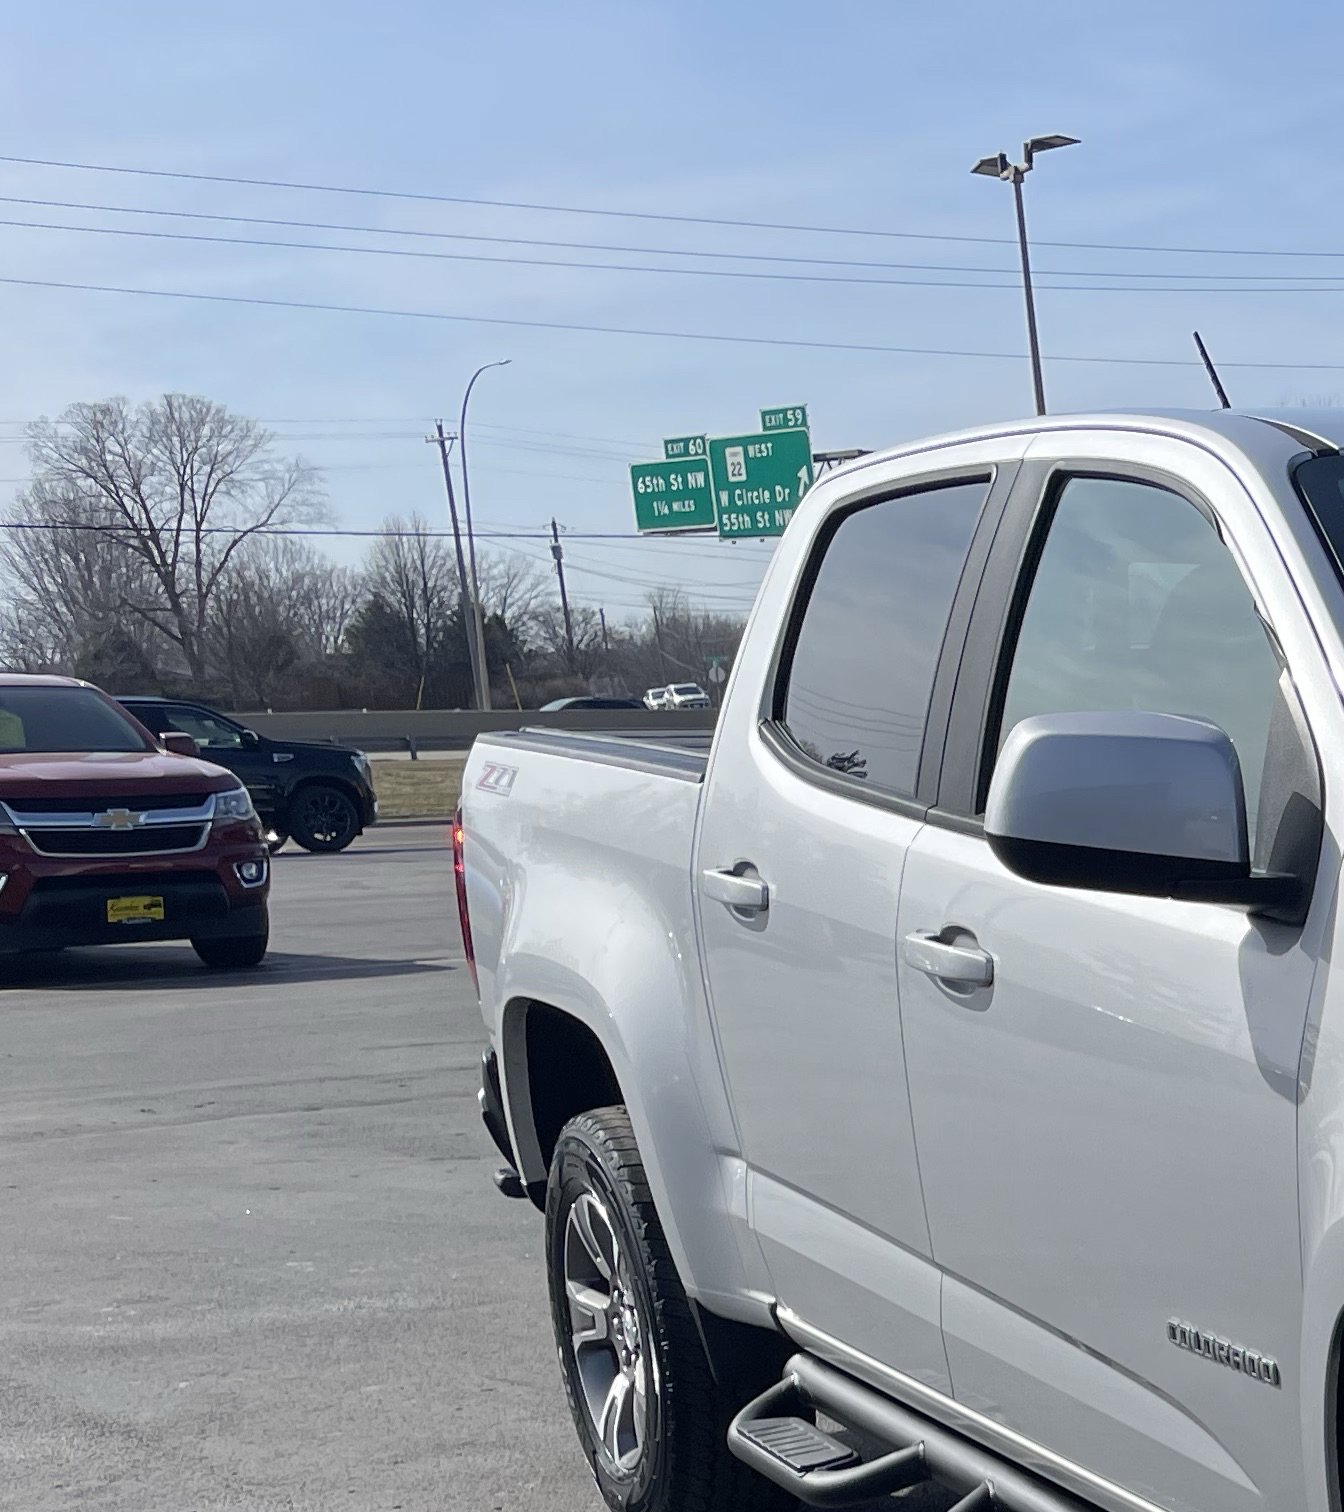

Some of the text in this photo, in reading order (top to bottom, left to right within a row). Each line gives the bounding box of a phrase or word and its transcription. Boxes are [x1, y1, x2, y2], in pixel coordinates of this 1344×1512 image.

[765, 409, 803, 427] EXIT 59
[667, 439, 703, 454] EXIT 60
[747, 443, 772, 458] WEST
[730, 461, 743, 477] 22
[637, 471, 705, 494] 65th St NW
[719, 485, 790, 507] W Circle Dr
[672, 499, 695, 513] MILES
[722, 509, 793, 531] 55th St NW
[1167, 1319, 1281, 1389] COLORADO
